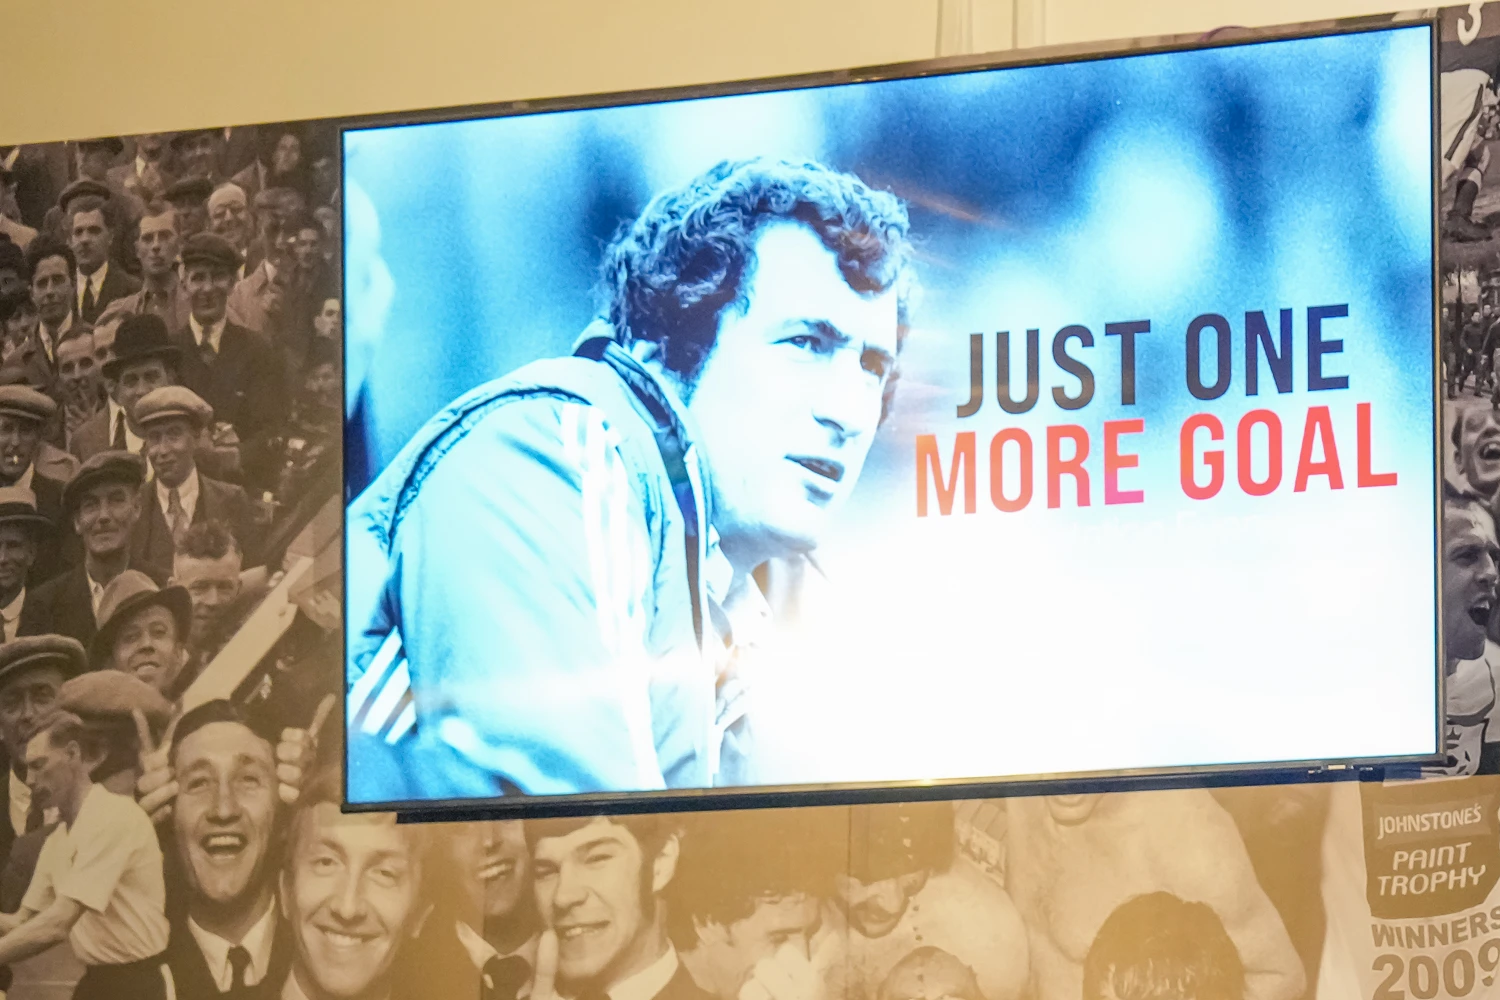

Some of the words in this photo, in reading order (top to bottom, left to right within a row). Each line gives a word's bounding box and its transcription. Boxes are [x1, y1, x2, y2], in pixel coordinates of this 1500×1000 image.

[957, 319, 1151, 418] JUST
[1186, 303, 1349, 400] ONE
[915, 418, 1145, 517] MORE
[1179, 403, 1398, 500] GOAL
[1377, 865, 1487, 897] TROPHY
[1392, 842, 1472, 870] PAINT
